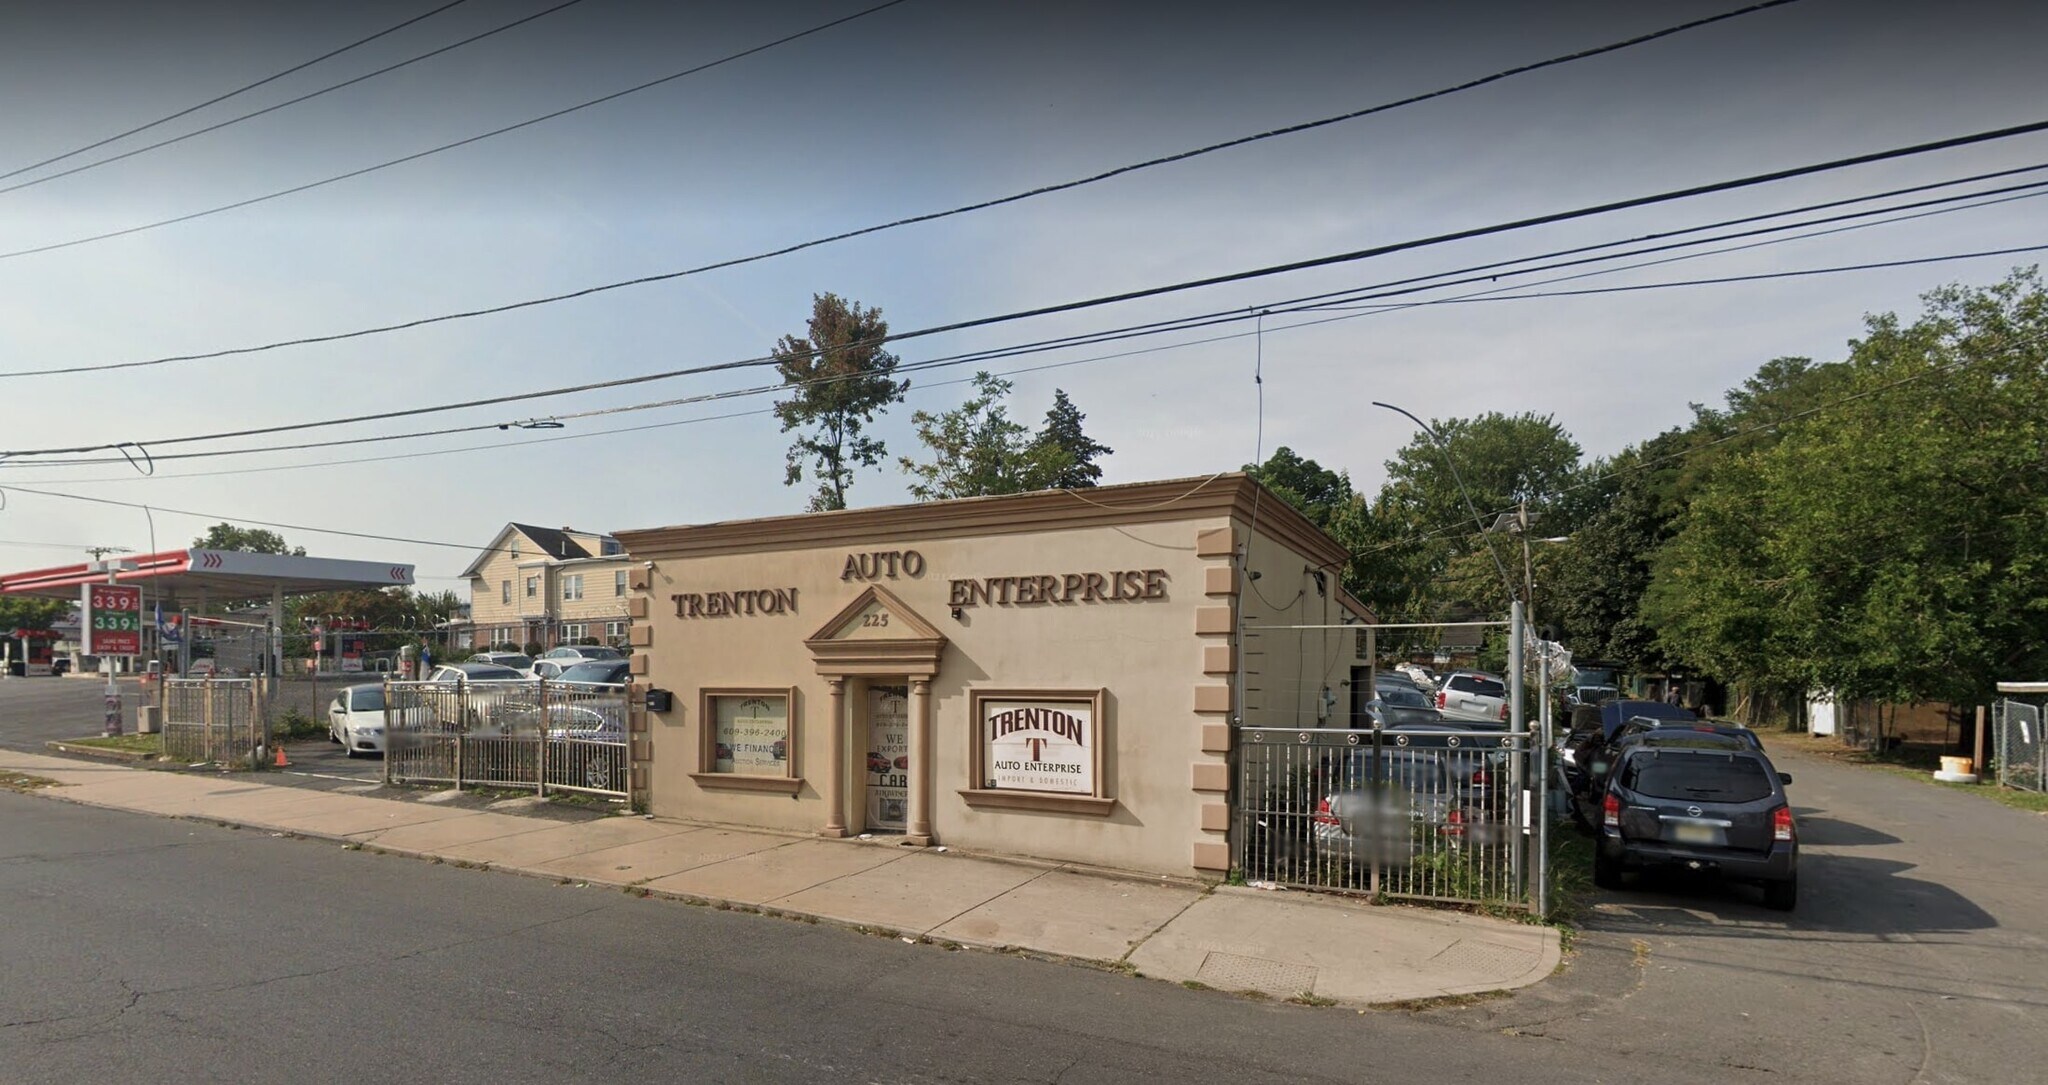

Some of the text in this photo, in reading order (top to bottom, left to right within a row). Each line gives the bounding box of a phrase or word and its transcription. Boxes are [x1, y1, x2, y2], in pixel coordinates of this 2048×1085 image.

[671, 550, 1168, 618] TRENTON AUTO ENTERPRISE
[863, 613, 889, 627] 225
[723, 727, 787, 737] 609-396-2400
[988, 708, 1083, 747] TRENTON
[886, 734, 904, 744] WE
[730, 743, 742, 752] WE
[1026, 738, 1047, 762] T
[995, 761, 1082, 774] AUTO ENTERPRISE
[998, 775, 1025, 784] IMPORT
[1039, 777, 1078, 787] DOMESTIC
